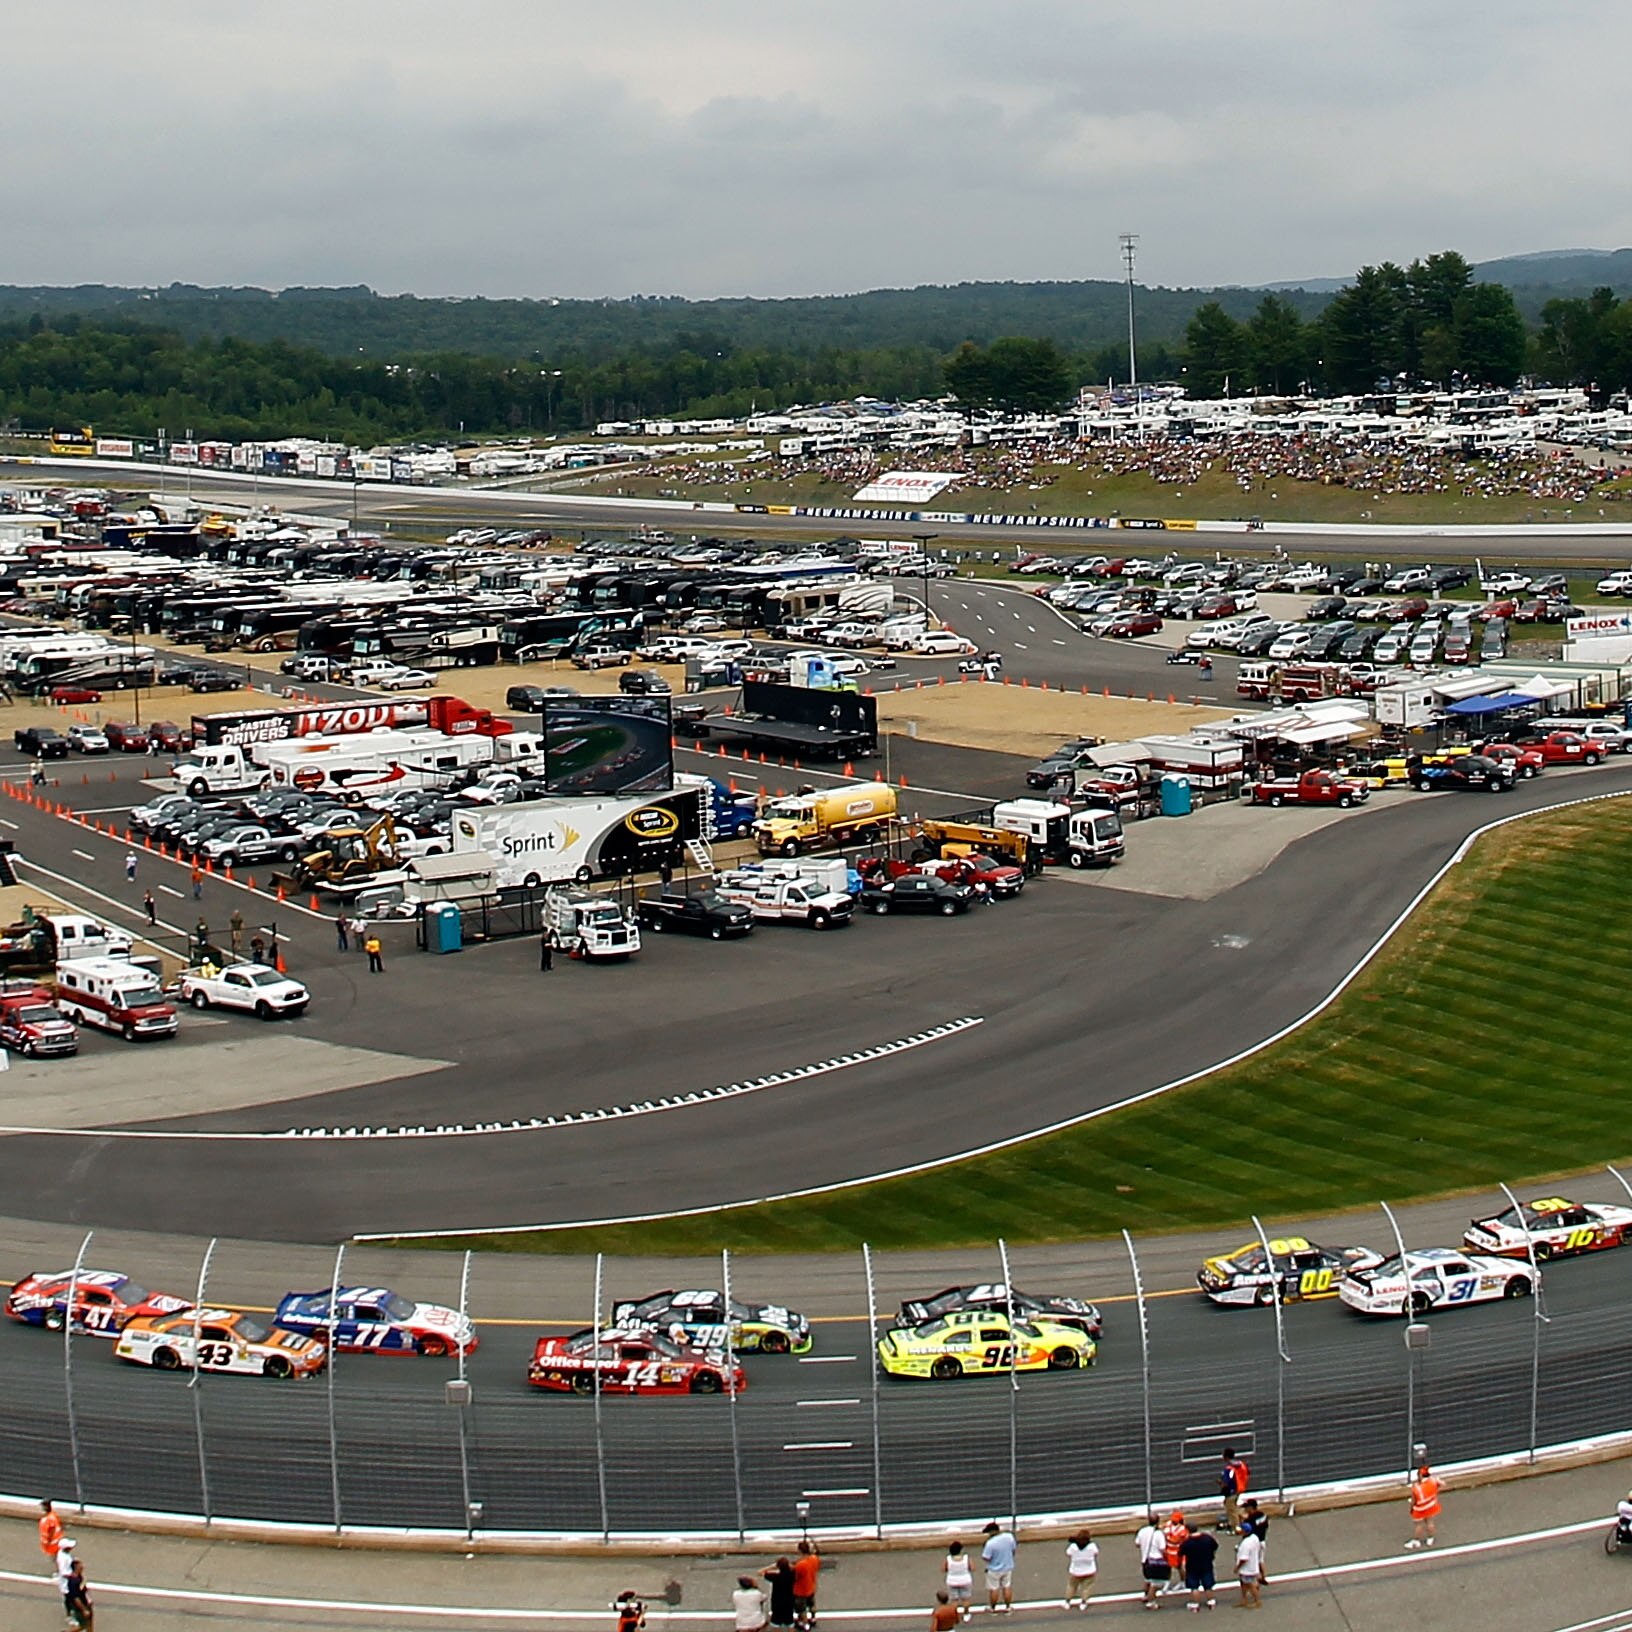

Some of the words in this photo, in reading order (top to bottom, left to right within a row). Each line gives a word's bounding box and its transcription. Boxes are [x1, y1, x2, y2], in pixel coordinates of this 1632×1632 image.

[872, 477, 932, 487] LENOX
[806, 508, 834, 517] NEW
[835, 509, 911, 521] HAMPSHIRE
[973, 514, 1003, 524] NEW
[1005, 515, 1096, 528] HAMPSHIRE
[1570, 619, 1618, 630] LENOX
[239, 717, 284, 733] FASTEST
[297, 706, 391, 737] IZOD
[223, 725, 289, 745] DRIVERS
[503, 831, 555, 858] Sprint
[1565, 1228, 1595, 1250] 16
[1299, 1267, 1334, 1294] 00
[1448, 1278, 1479, 1301] 31
[85, 1305, 114, 1329] 47
[618, 1318, 659, 1333] Aflac
[353, 1323, 391, 1347] 77
[692, 1325, 728, 1347] 99
[197, 1343, 233, 1366] 43
[539, 1355, 581, 1368] Office
[982, 1345, 1019, 1368] 98
[621, 1362, 661, 1386] 14
